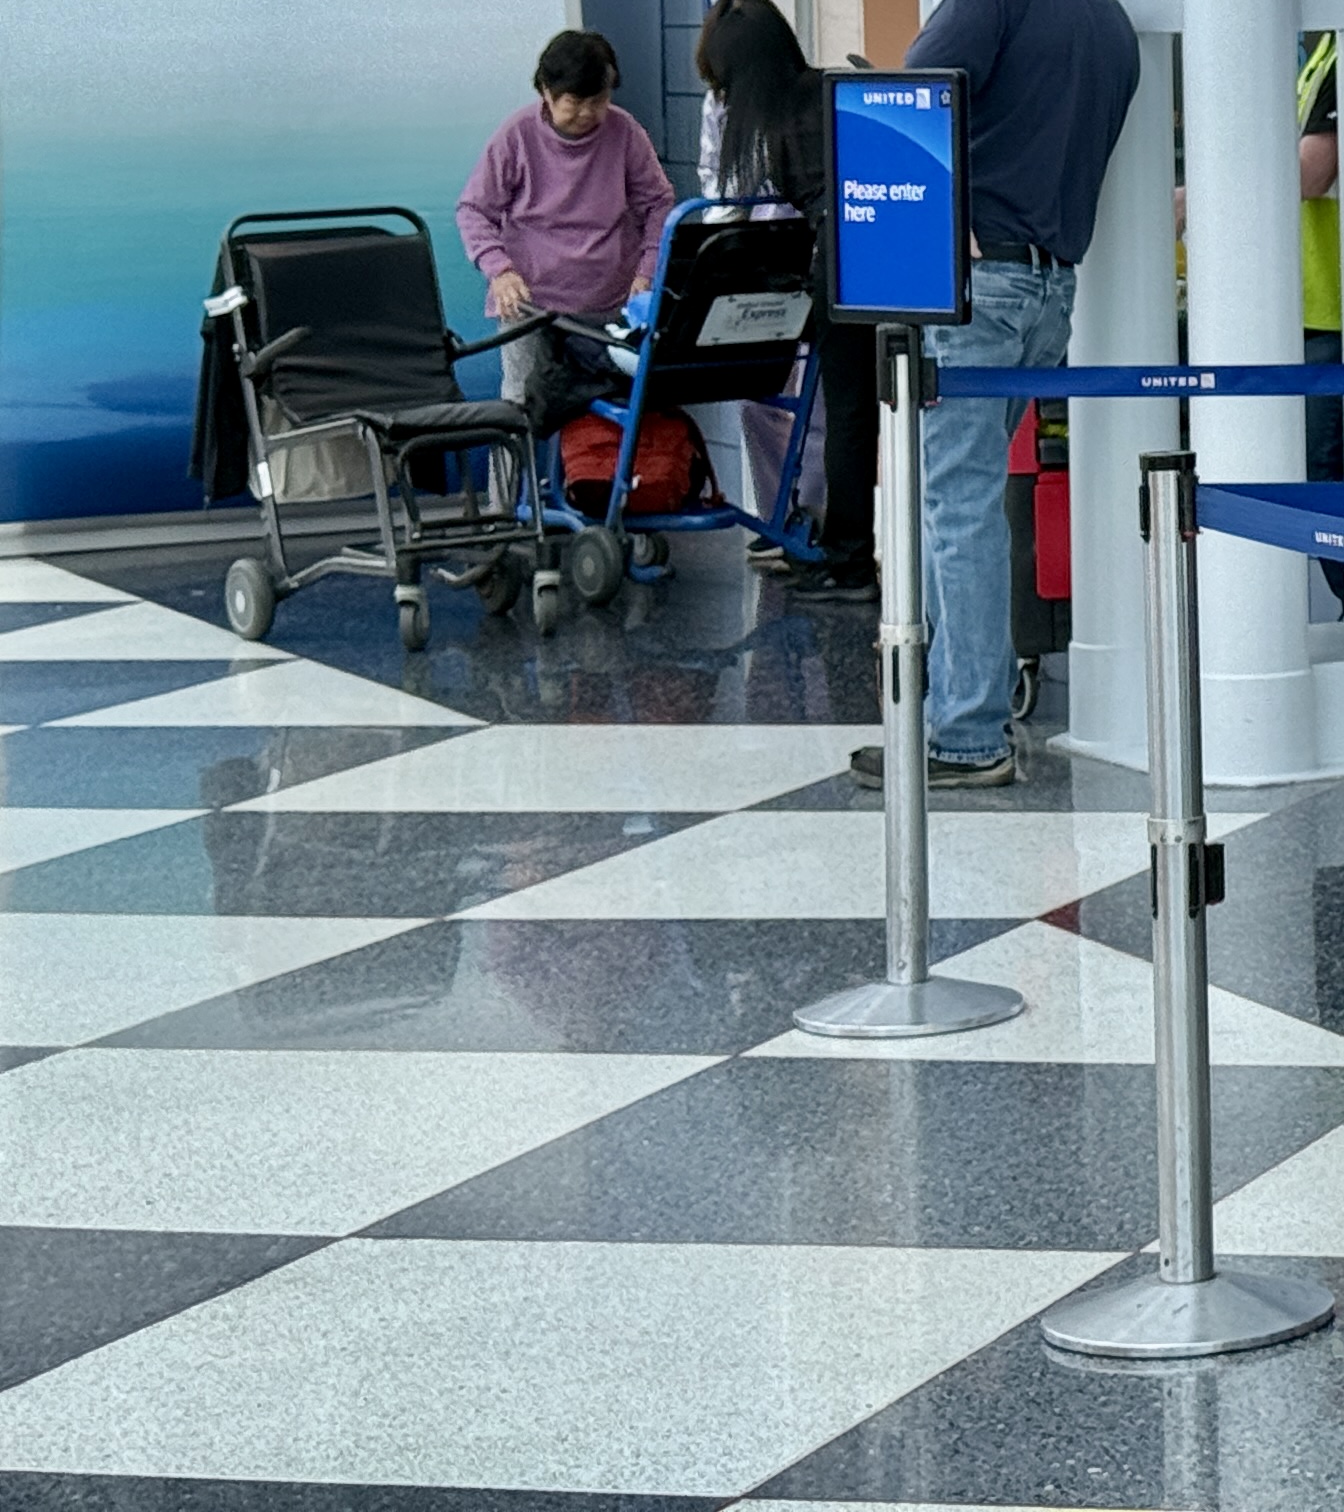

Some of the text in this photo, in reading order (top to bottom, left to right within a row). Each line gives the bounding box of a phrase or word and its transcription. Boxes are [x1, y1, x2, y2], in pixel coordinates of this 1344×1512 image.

[863, 92, 914, 105] UNITED
[844, 180, 926, 201] Please enter
[844, 202, 876, 222] here
[1141, 376, 1198, 387] UNITED
